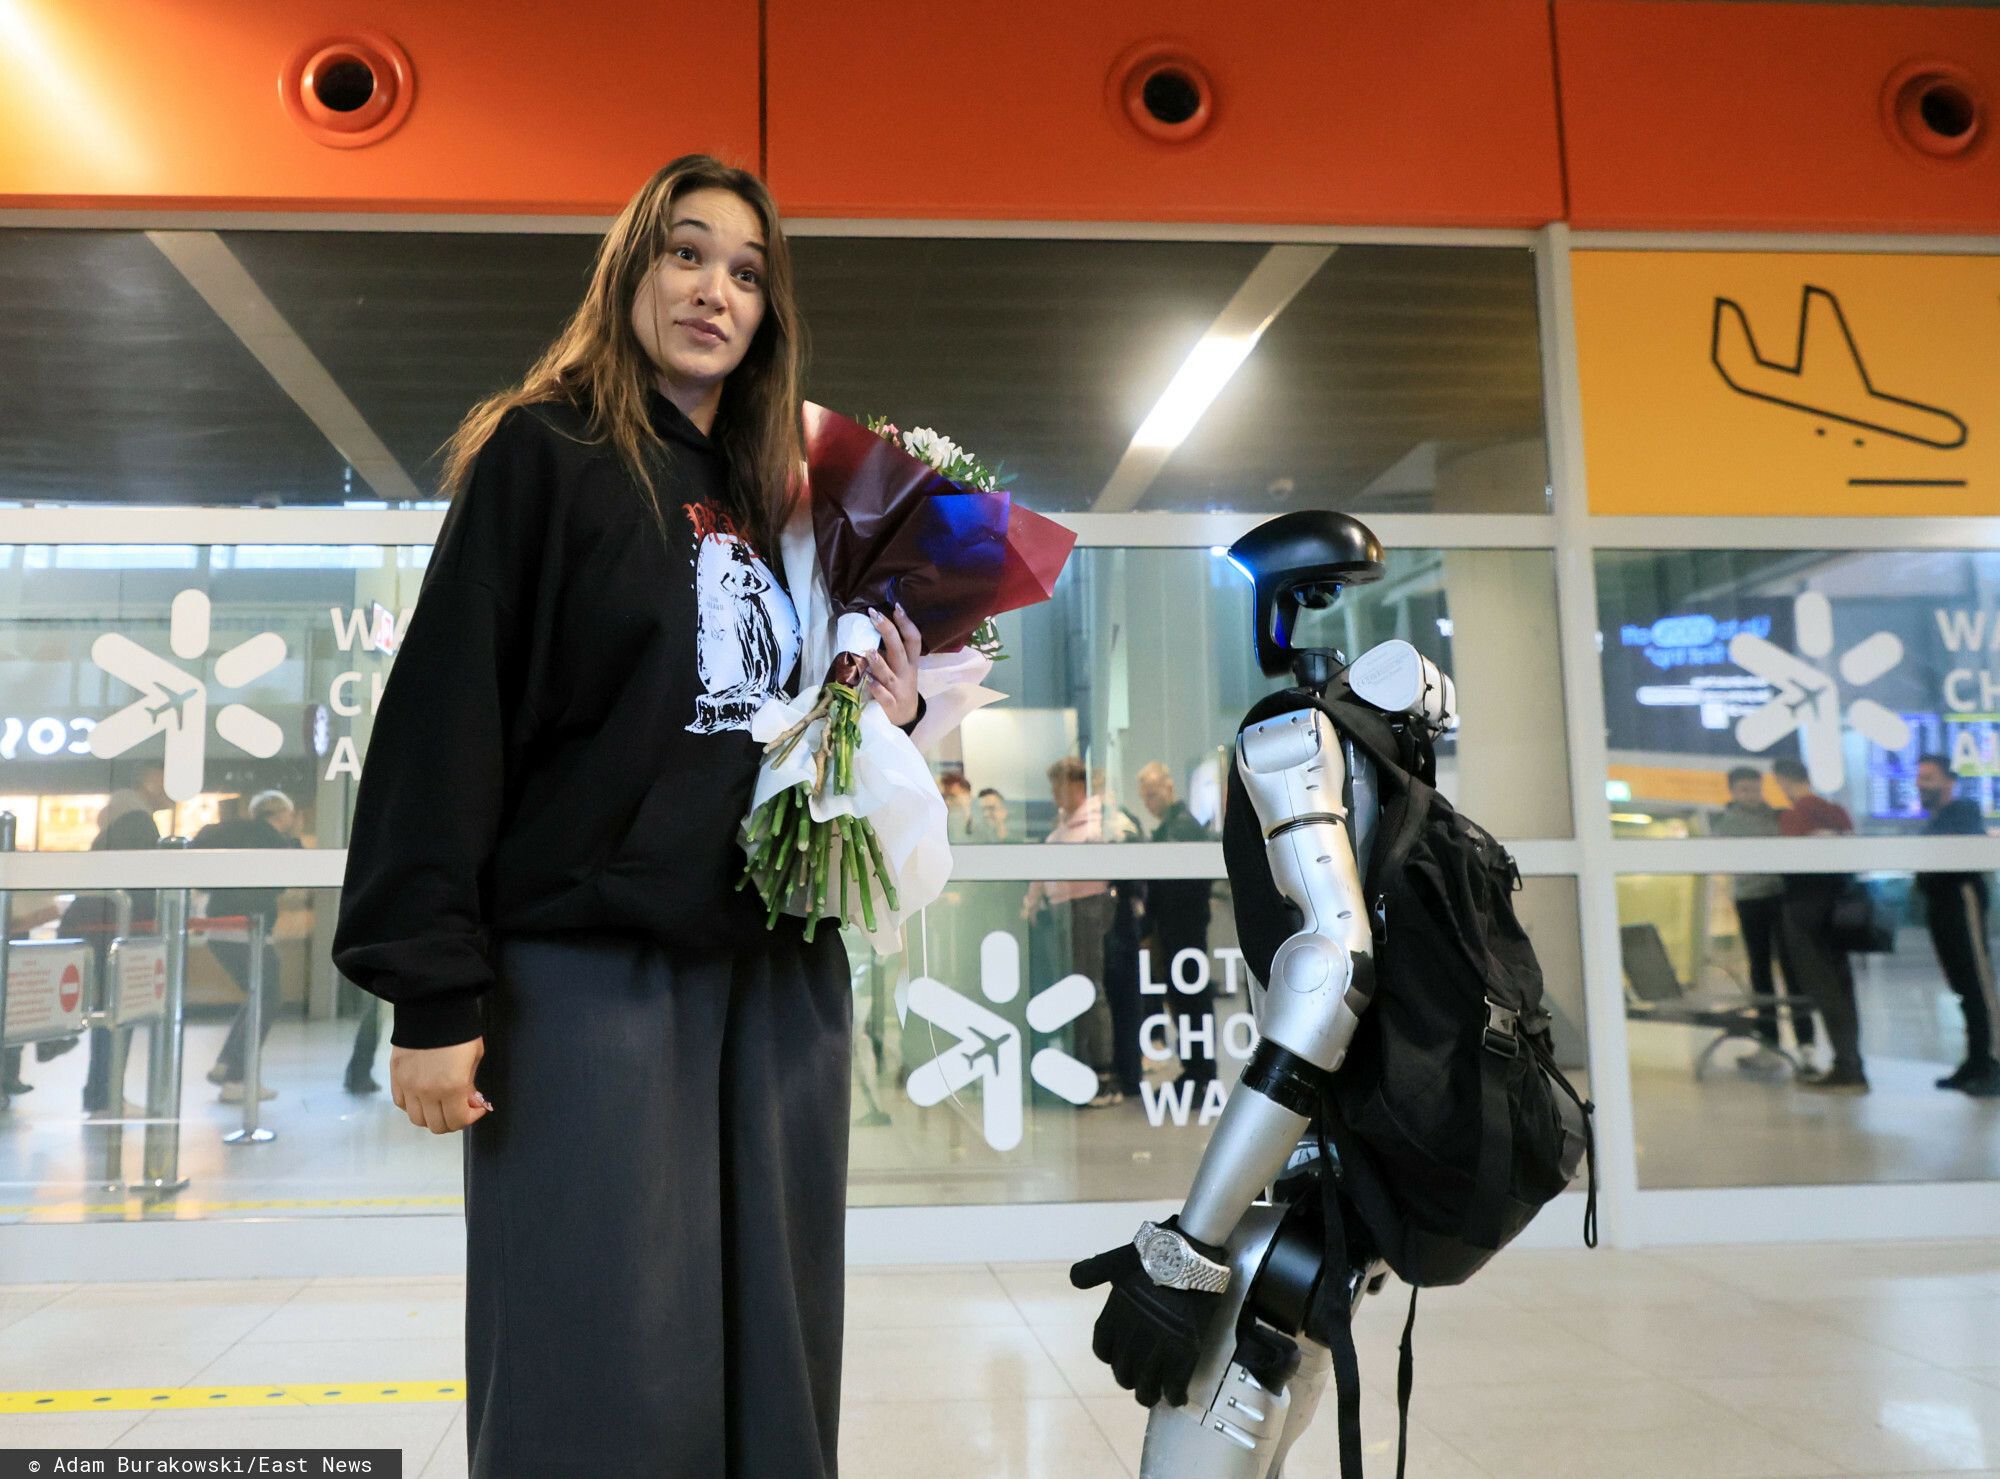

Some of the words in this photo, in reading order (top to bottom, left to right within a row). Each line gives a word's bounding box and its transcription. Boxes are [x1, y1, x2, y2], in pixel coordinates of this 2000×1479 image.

[1138, 947, 1243, 995] LOT
[1139, 1012, 1259, 1061] CHO
[1139, 1079, 1230, 1127] WA
